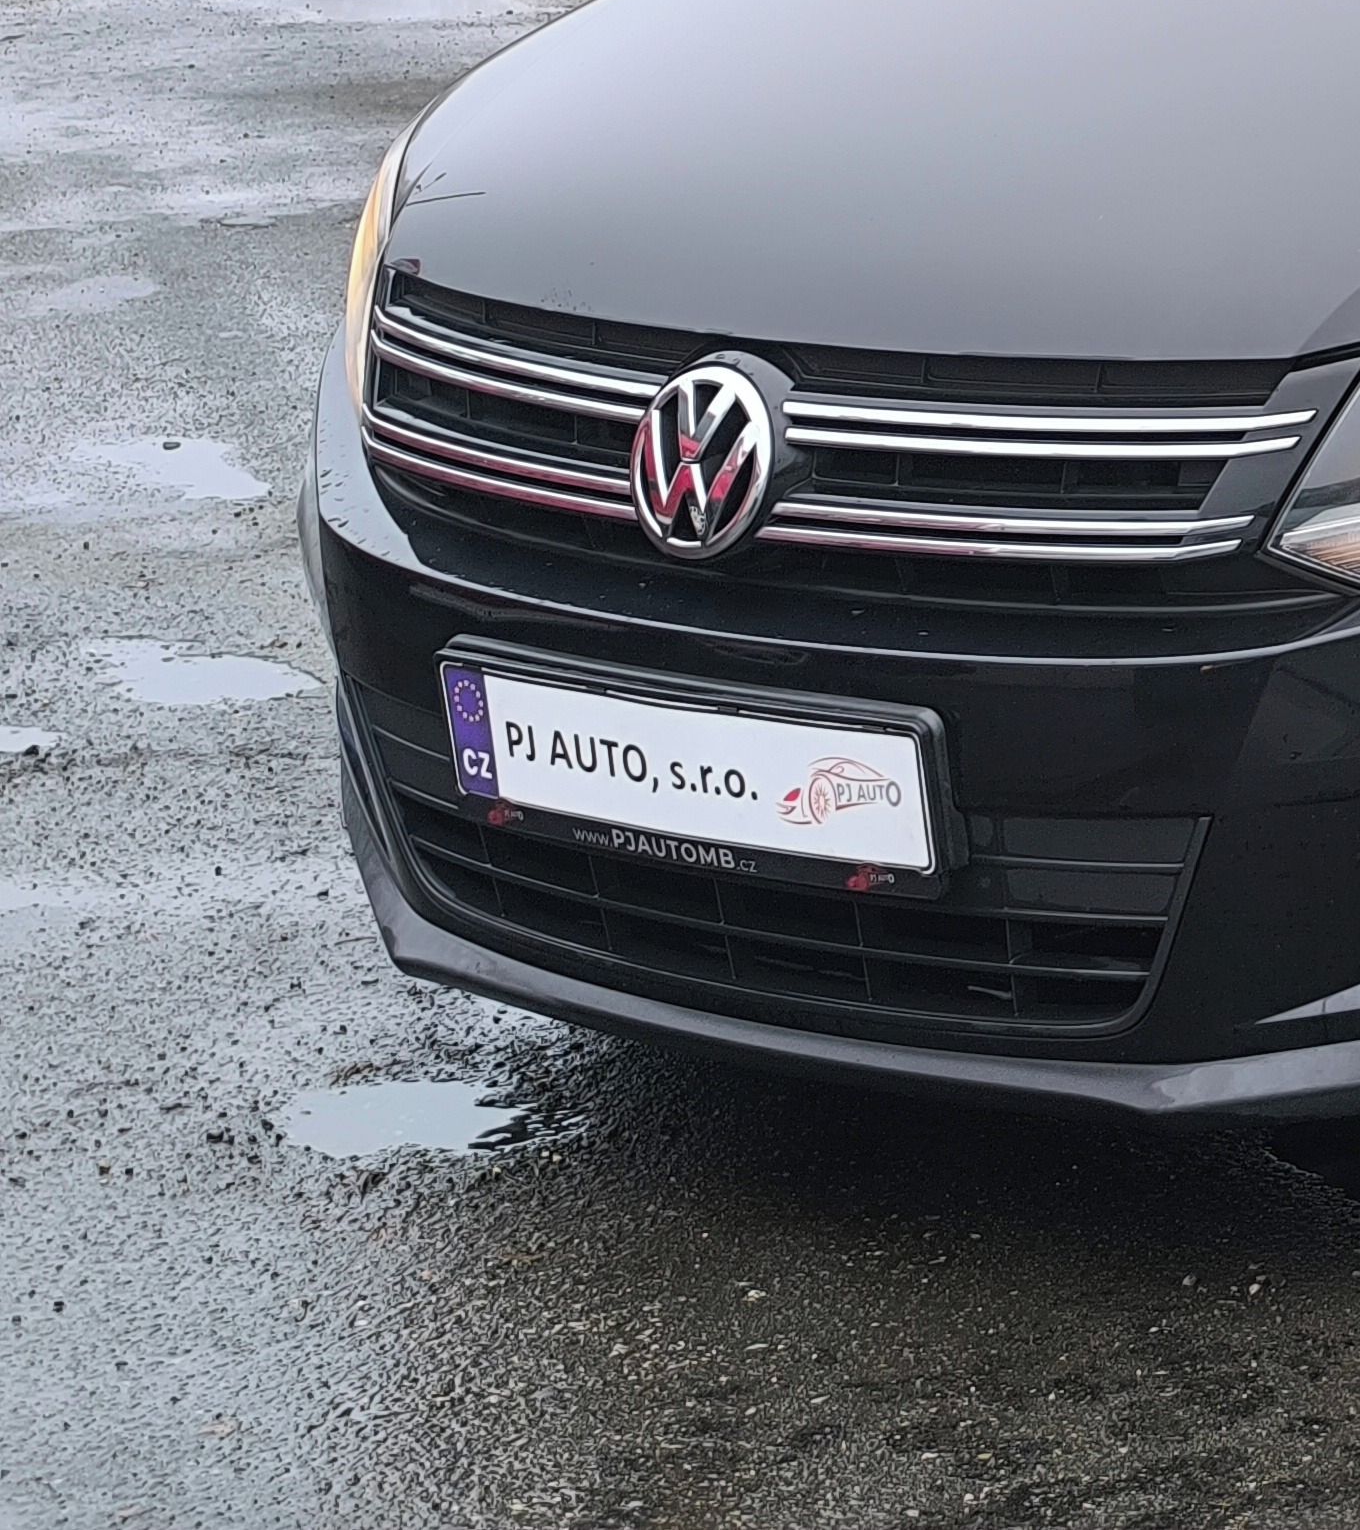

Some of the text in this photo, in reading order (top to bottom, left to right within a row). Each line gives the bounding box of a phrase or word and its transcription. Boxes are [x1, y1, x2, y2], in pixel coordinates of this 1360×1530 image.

[462, 748, 493, 780] CZ
[505, 720, 759, 801] PJ AUTO, s.r.o.
[836, 779, 902, 808] PJ AUTO
[572, 827, 758, 873] www.PJAUTOMB.cz
